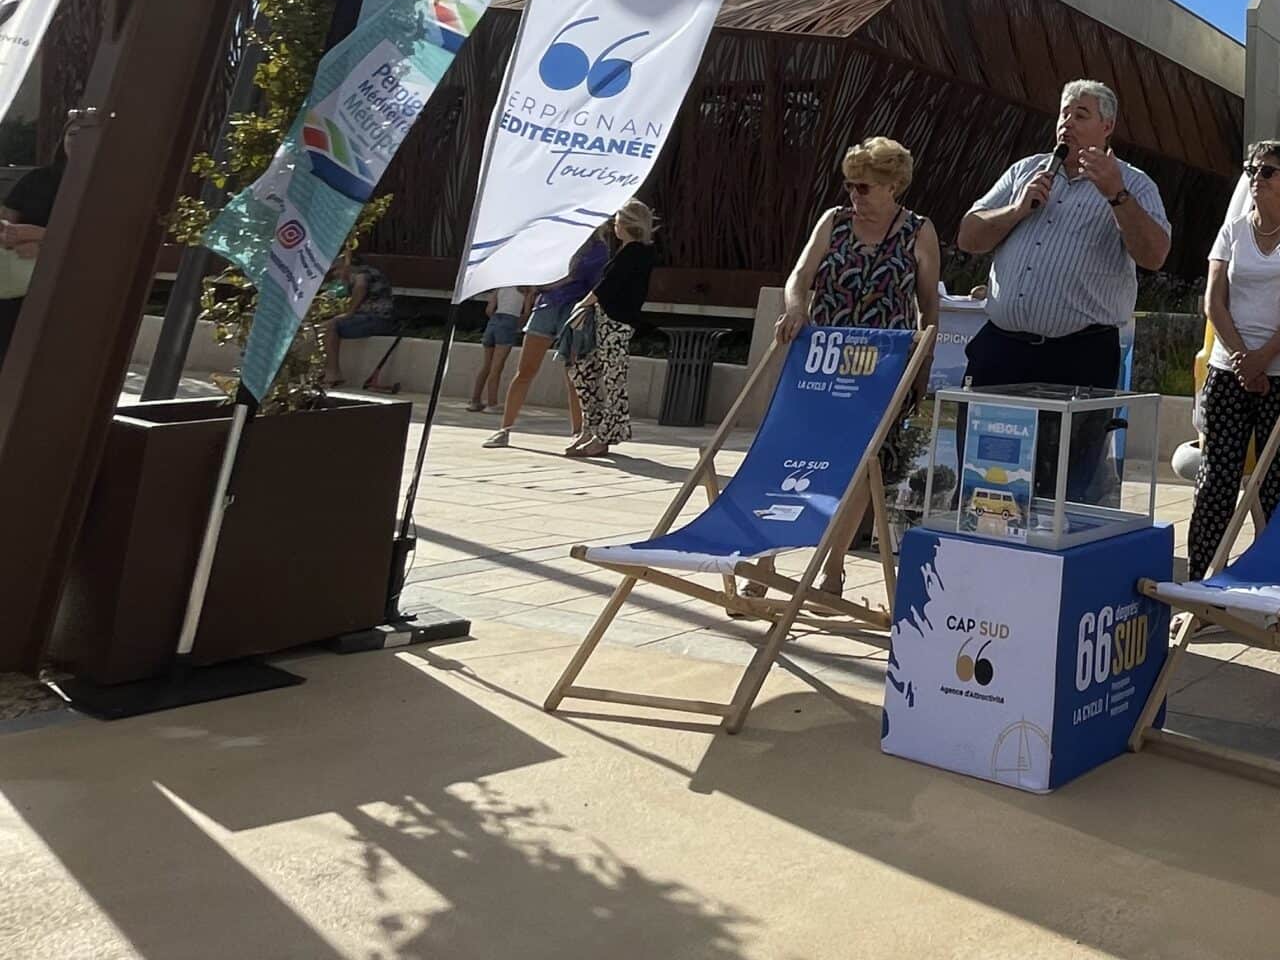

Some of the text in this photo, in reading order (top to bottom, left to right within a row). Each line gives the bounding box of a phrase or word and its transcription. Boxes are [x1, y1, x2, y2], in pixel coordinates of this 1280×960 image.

[546, 148, 640, 186] Tourisme
[804, 330, 843, 374] 66
[839, 345, 878, 376] SUD
[971, 420, 1029, 437] TMBOLA
[784, 460, 829, 470] CAP SUD
[946, 616, 1010, 639] CAP SUD
[1076, 606, 1114, 691] 66
[1112, 615, 1148, 675] SUD
[1073, 698, 1103, 726] LA CYCLO
